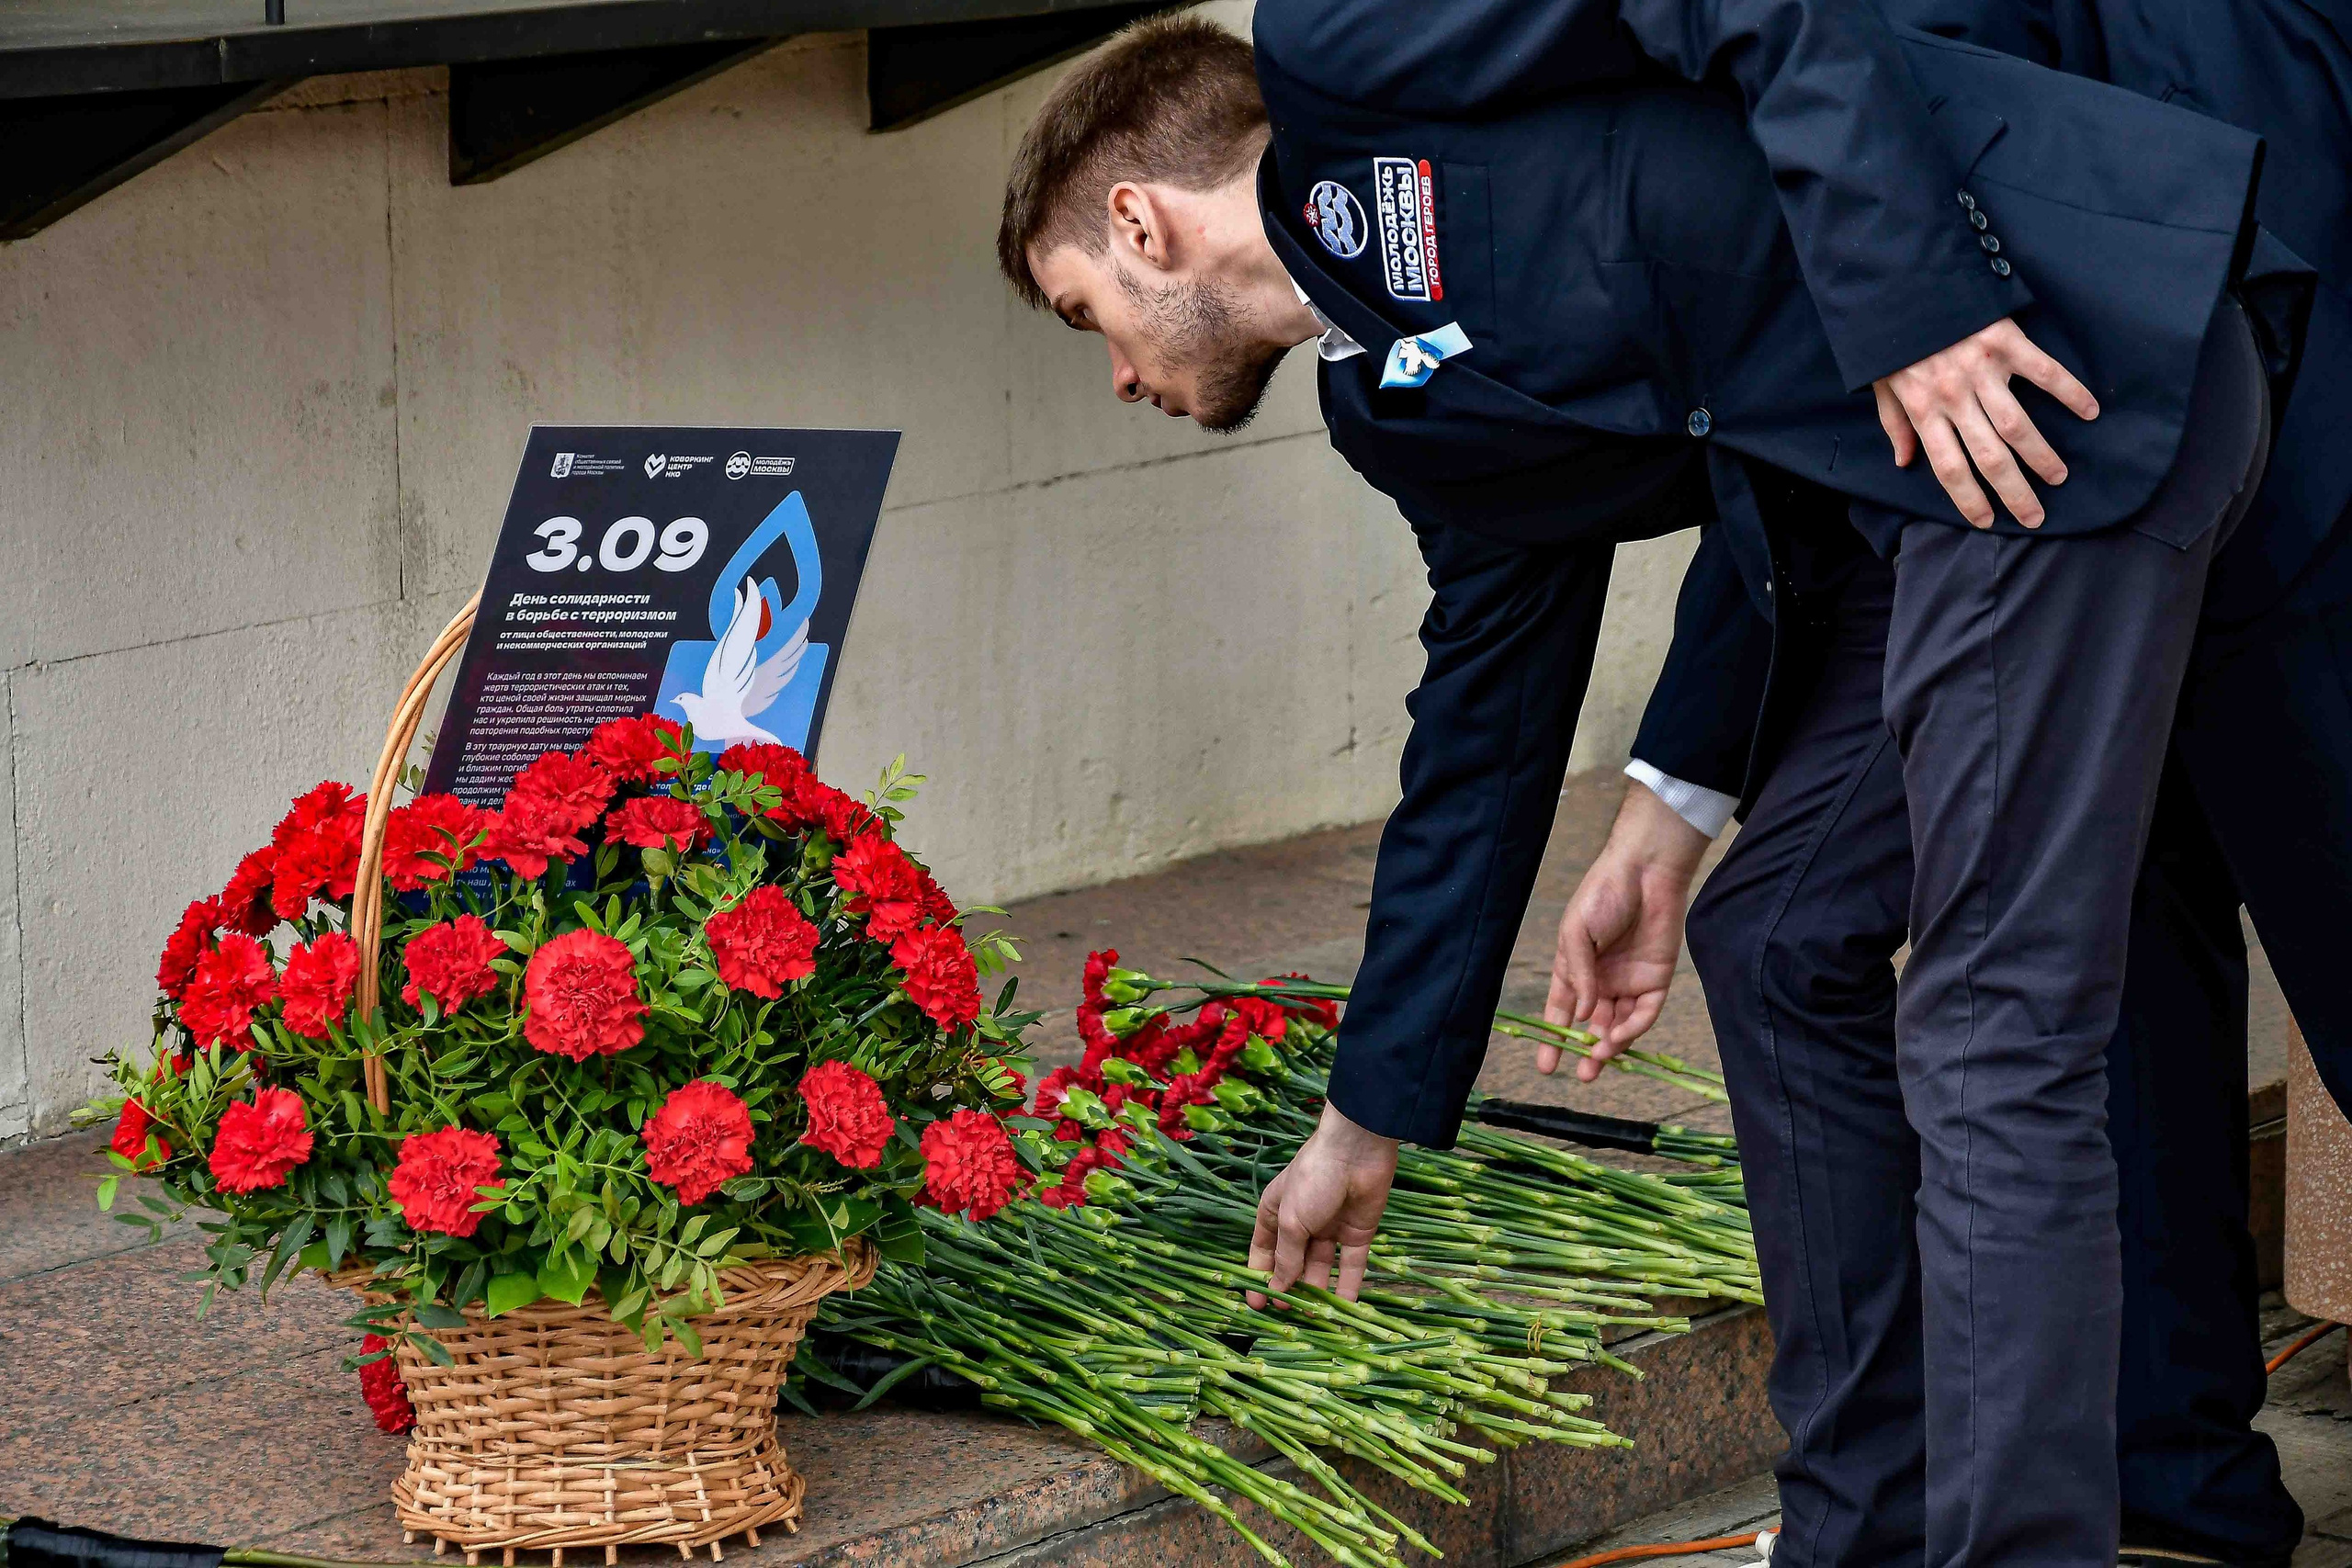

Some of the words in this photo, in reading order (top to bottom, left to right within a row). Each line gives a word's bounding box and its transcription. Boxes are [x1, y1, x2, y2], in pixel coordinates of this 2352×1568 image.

[1420, 175, 1436, 233] ГЕРОЕВ
[1382, 165, 1405, 291] МОЛОДЁЖЬ
[1396, 166, 1424, 291] МОСКВЫ
[1425, 234, 1441, 286] ГОРОД
[526, 515, 709, 573] 3.09
[509, 592, 548, 607] День
[549, 593, 650, 607] солидарности
[505, 611, 514, 621] в
[516, 608, 569, 624] борьбе
[570, 610, 579, 620] с
[581, 610, 677, 624] терроризмом
[500, 631, 512, 639] от
[512, 631, 536, 641] лица
[537, 629, 617, 640] общественности,
[618, 630, 668, 640] молодежи
[496, 642, 503, 650] и
[503, 641, 586, 651] некоммерческих
[585, 640, 648, 651] организаций
[486, 671, 521, 681] Каждый
[521, 672, 536, 681] год
[561, 672, 582, 681] день
[483, 684, 509, 693] жертв
[511, 683, 586, 693] террористических
[614, 683, 629, 692] тех,
[495, 694, 522, 703] ценой
[522, 694, 548, 702] своей
[575, 694, 614, 703] защищал
[614, 694, 648, 704] мирных
[476, 705, 514, 715] граждан.
[515, 705, 544, 714] Общая
[544, 704, 564, 713] боль
[565, 705, 594, 715] утраты
[496, 716, 536, 726] укрепила
[537, 716, 582, 725] решимость
[469, 728, 519, 737] повторения
[519, 726, 562, 736] подобных
[465, 742, 471, 750] В
[472, 743, 487, 752] эту
[488, 742, 529, 752] траурную
[529, 743, 548, 751] дату
[461, 752, 501, 763] глубокие
[466, 763, 501, 773] близким
[503, 763, 527, 773] погиб
[452, 786, 501, 796] продолжим
